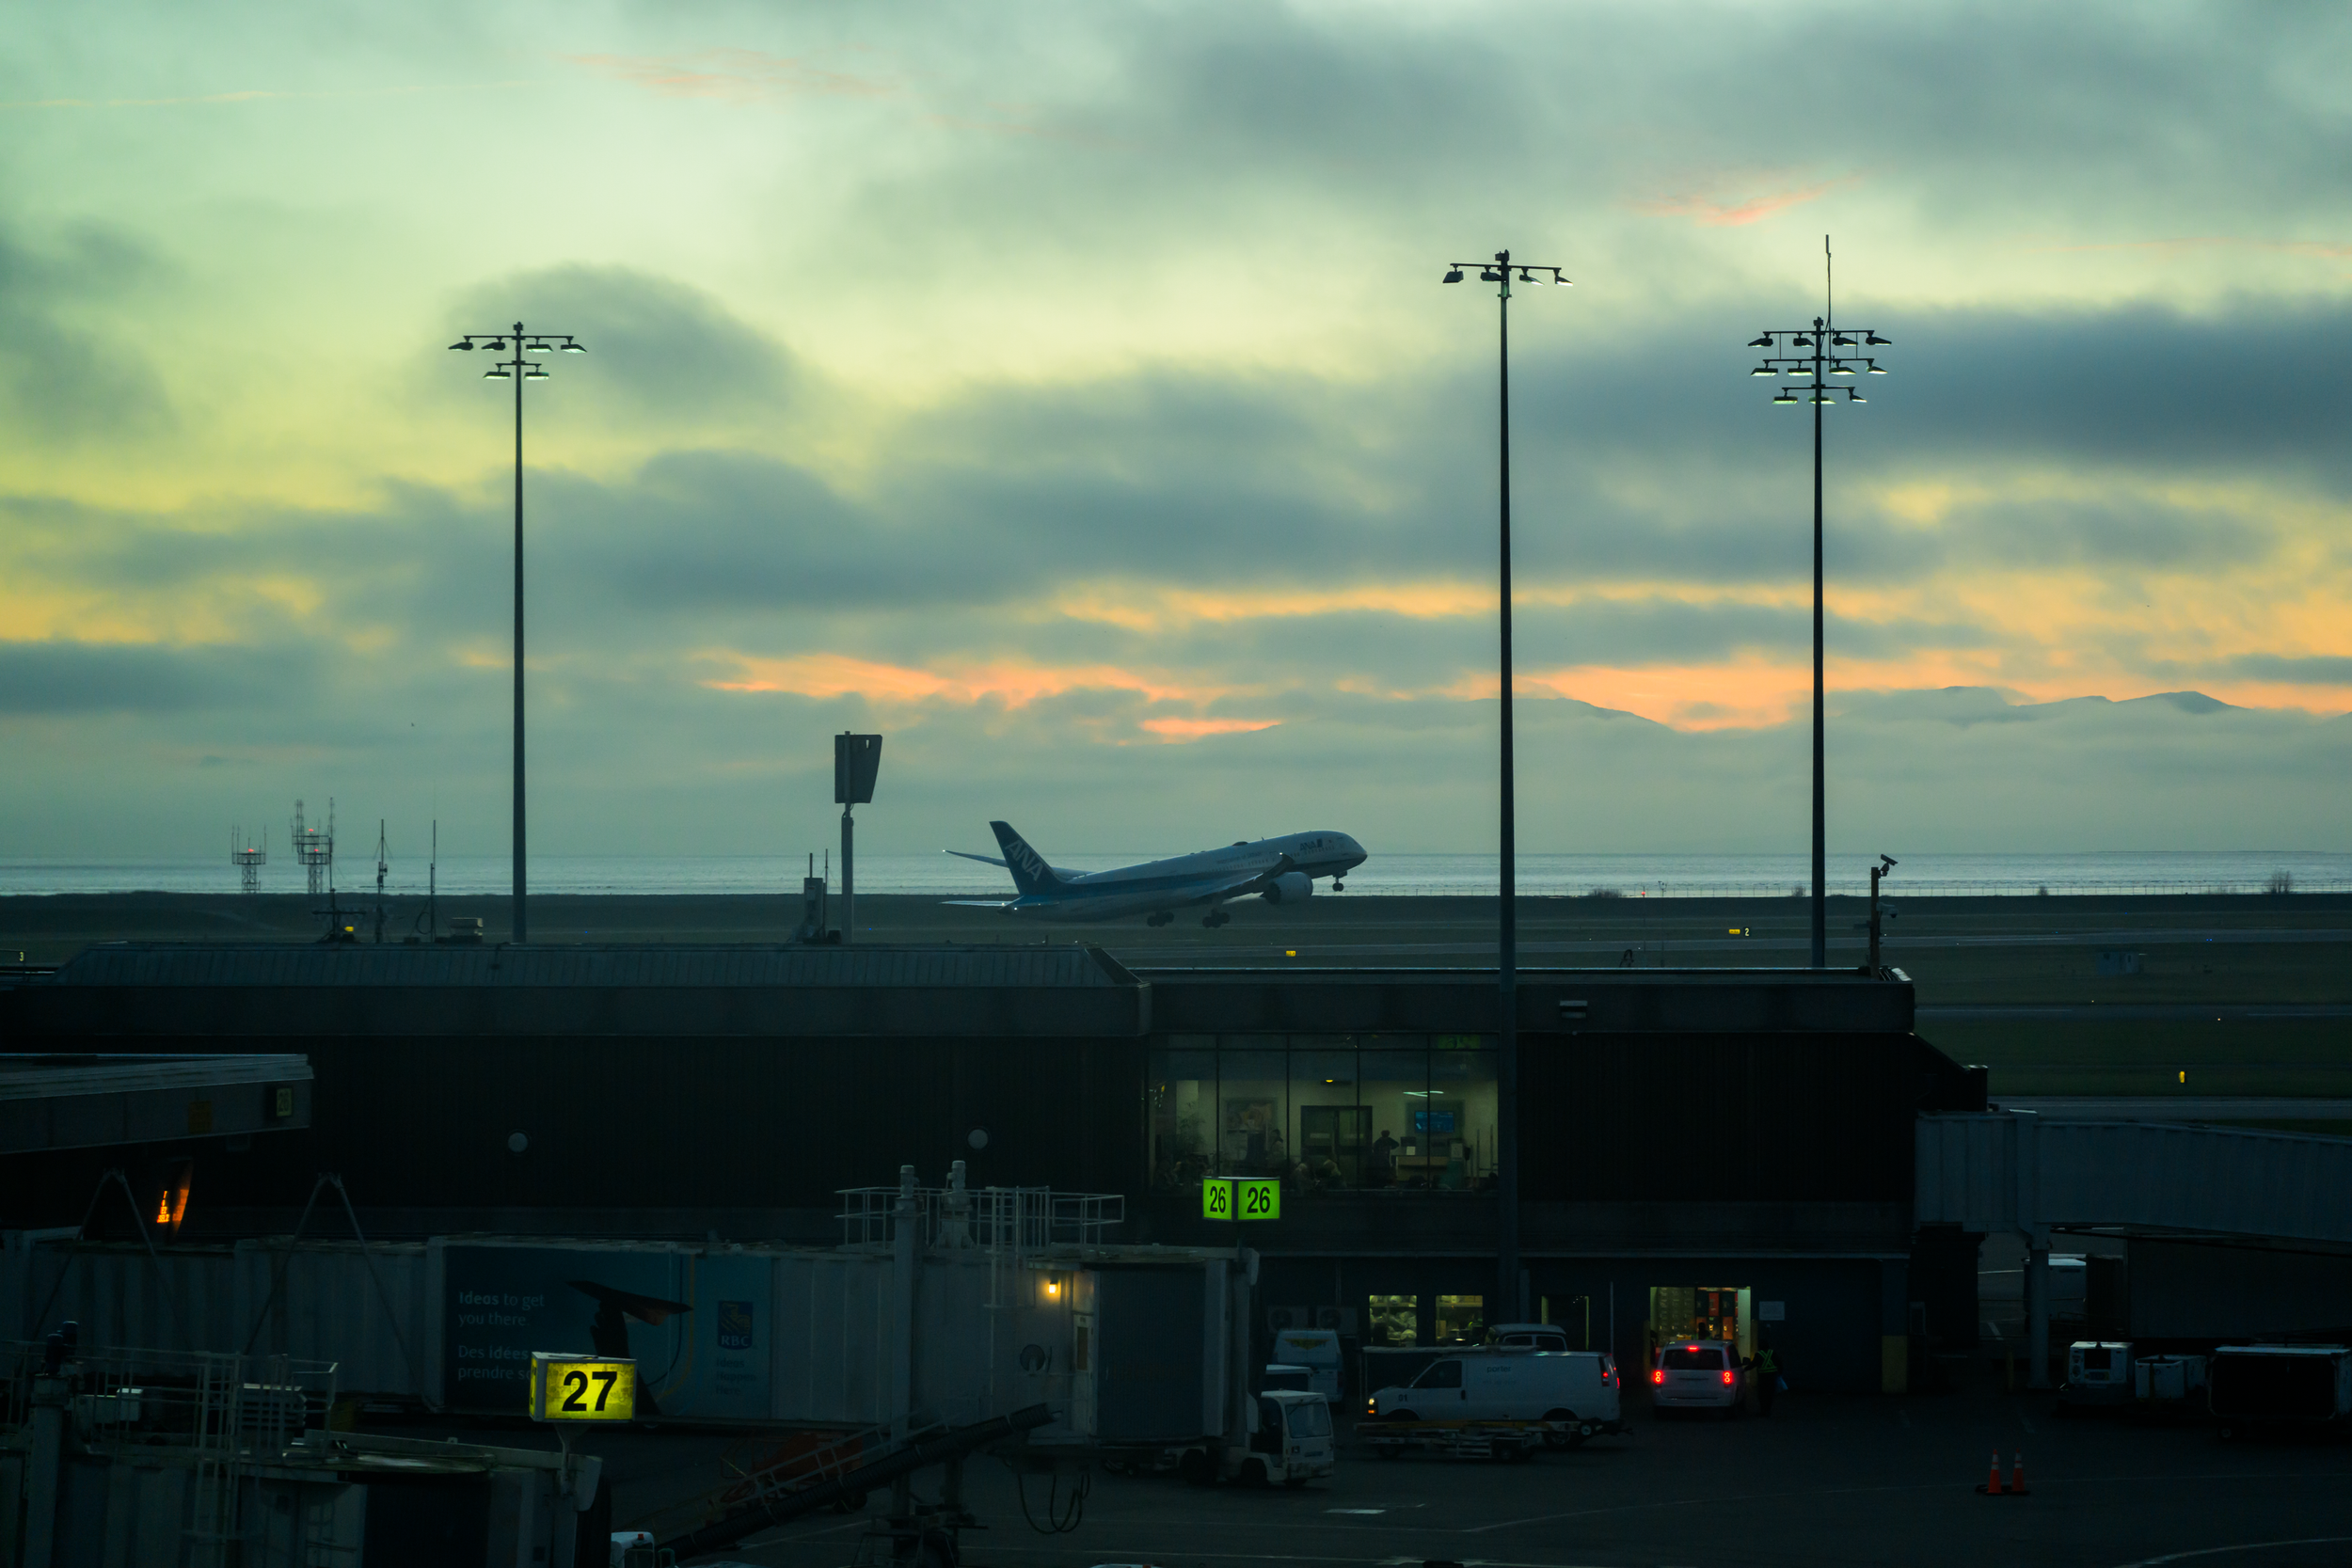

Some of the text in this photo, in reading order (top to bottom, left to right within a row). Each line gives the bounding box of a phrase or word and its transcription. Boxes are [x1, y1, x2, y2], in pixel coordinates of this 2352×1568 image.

[1004, 839, 1043, 881] ANA
[1209, 1185, 1227, 1213] 26
[1247, 1186, 1271, 1213] 26
[458, 1291, 545, 1311] Ideas to get
[458, 1311, 531, 1327] you there.
[721, 1335, 749, 1347] RBC
[458, 1345, 529, 1360] Des idées
[716, 1357, 745, 1369] Ideas
[1486, 1365, 1511, 1373] porter
[458, 1366, 514, 1382] prendre
[716, 1370, 756, 1383] Happen
[562, 1370, 617, 1412] 27
[715, 1385, 741, 1396] Here
